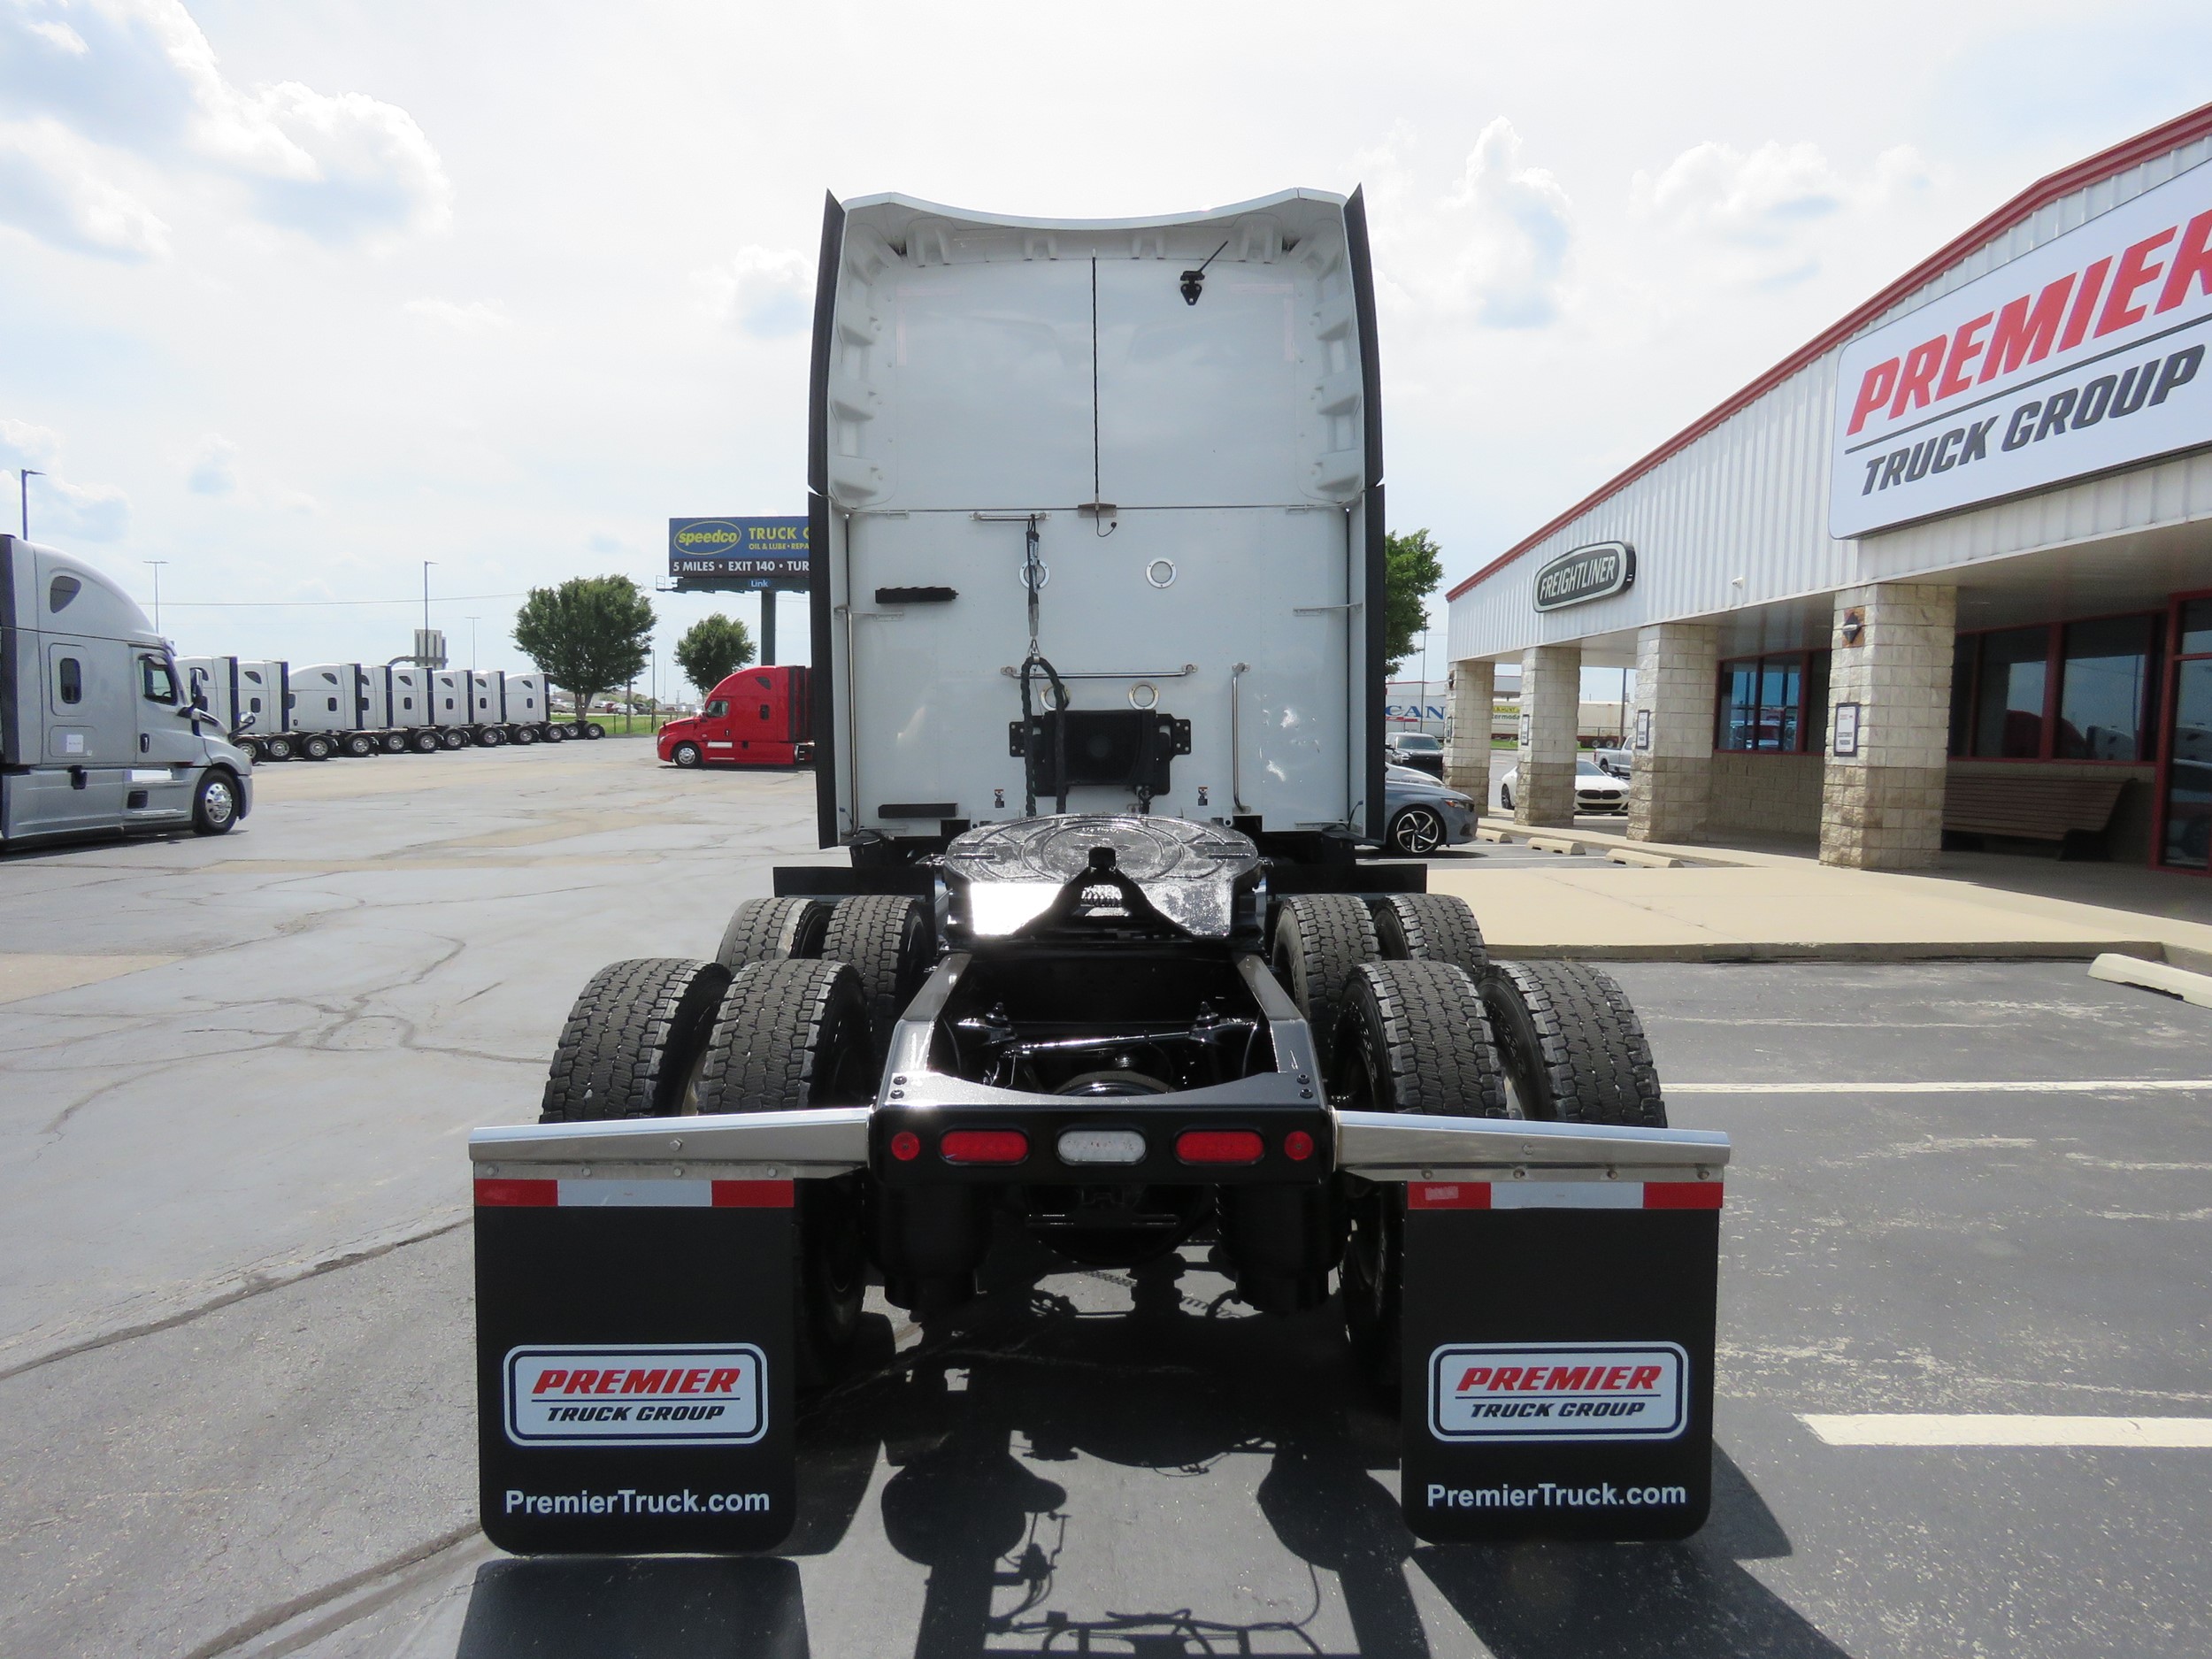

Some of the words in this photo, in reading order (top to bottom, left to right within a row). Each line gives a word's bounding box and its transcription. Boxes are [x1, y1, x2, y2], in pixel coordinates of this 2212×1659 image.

[1846, 209, 2212, 436] PREMIER
[1862, 415, 1999, 496] TRUCK
[2001, 344, 2205, 452] GROUP
[678, 529, 738, 546] speedco
[749, 527, 797, 540] TRUCK
[672, 562, 680, 572] 5
[682, 562, 715, 572] MILES
[728, 561, 752, 571] EXIT
[756, 561, 775, 571] 140
[1540, 556, 1616, 601] FREIGHTLINER
[532, 1368, 741, 1394] PREMIER
[1456, 1365, 1663, 1392] PREMIER
[547, 1407, 633, 1422] TRUCK
[635, 1406, 726, 1421] GROUP
[1471, 1403, 1555, 1417] TRUCK
[1558, 1402, 1646, 1417] GROUP
[505, 1489, 770, 1514] PremierTruck.com
[1427, 1483, 1686, 1507] PremierTruck.com
